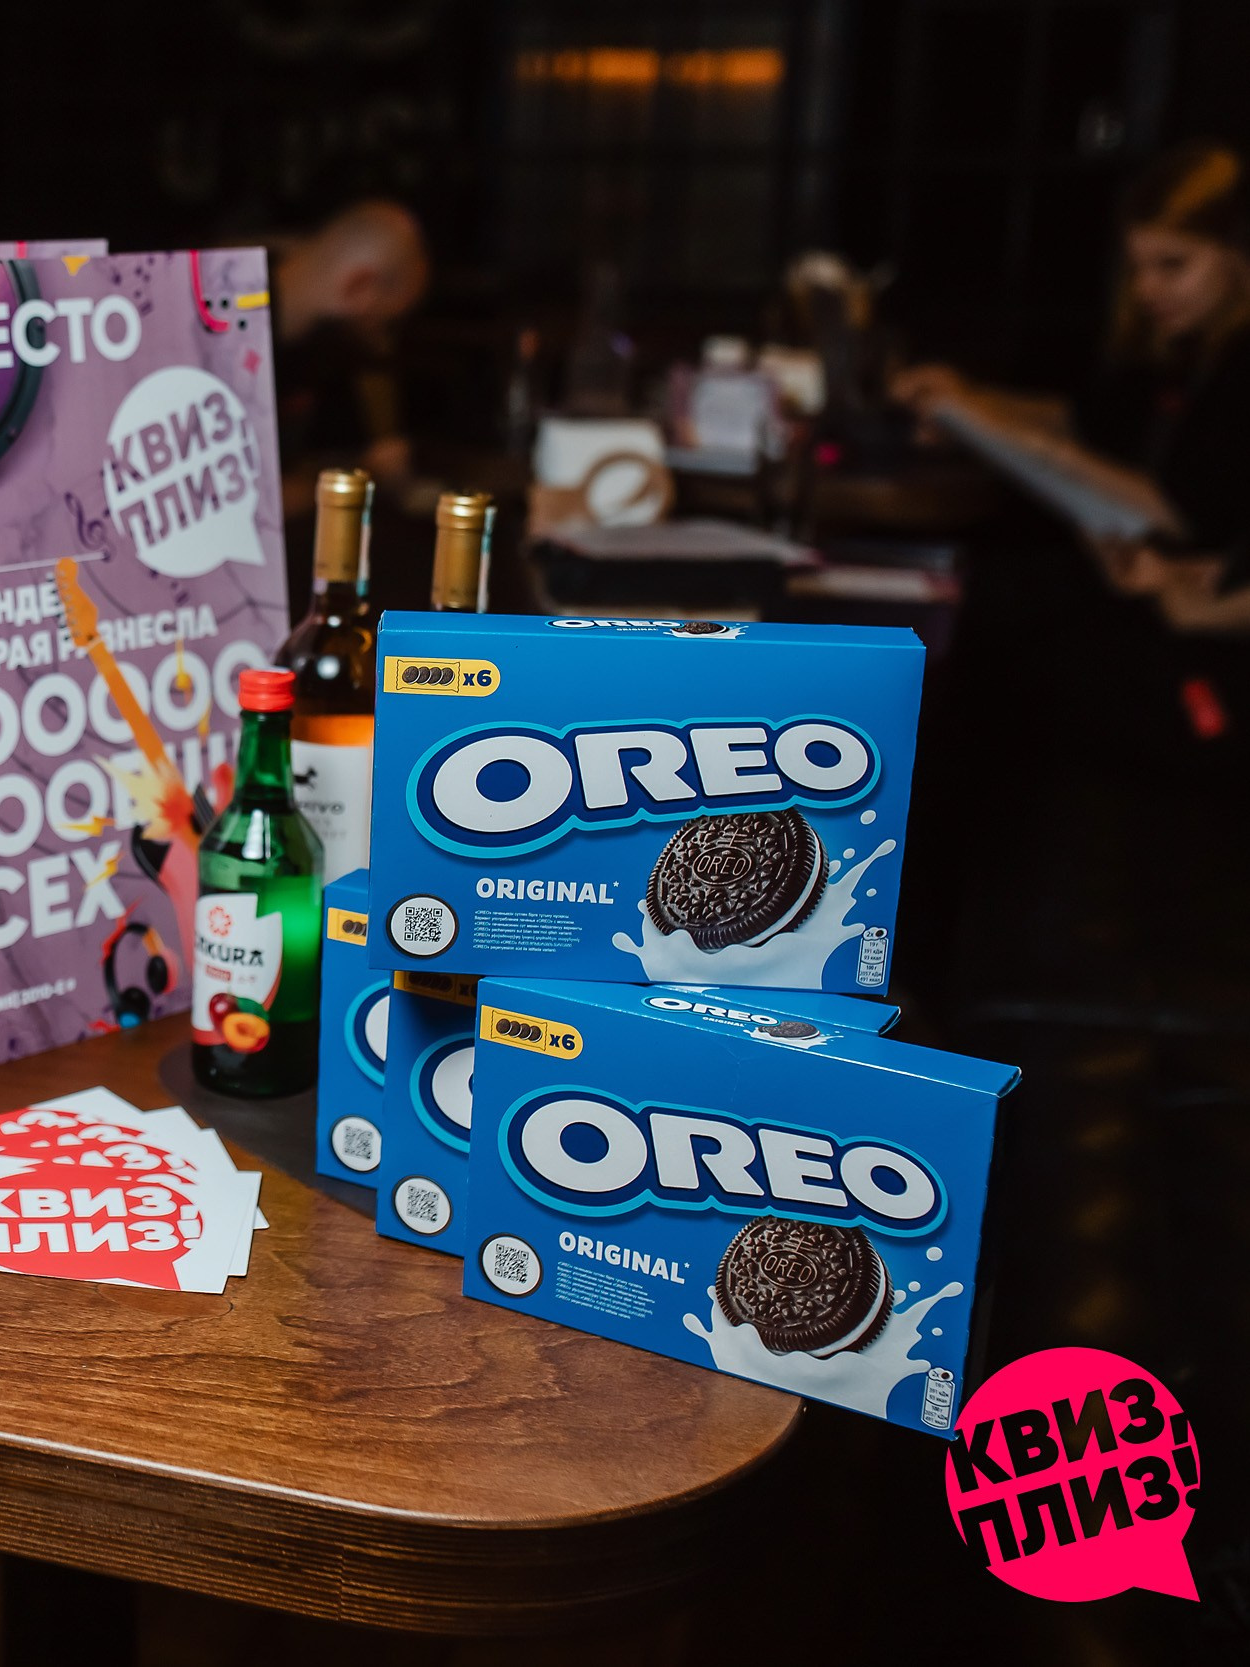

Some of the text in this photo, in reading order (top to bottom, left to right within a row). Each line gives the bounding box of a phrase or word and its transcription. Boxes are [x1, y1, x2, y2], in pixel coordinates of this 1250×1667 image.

[58, 604, 218, 662] РЗНЕСЛА
[551, 619, 682, 628] OREO
[463, 669, 493, 687] x6
[433, 722, 869, 833] OREO
[697, 855, 747, 876] OREO
[650, 997, 778, 1025] OREO
[549, 1034, 576, 1051] x6
[521, 1099, 937, 1220] OREO
[764, 1255, 812, 1282] OREO
